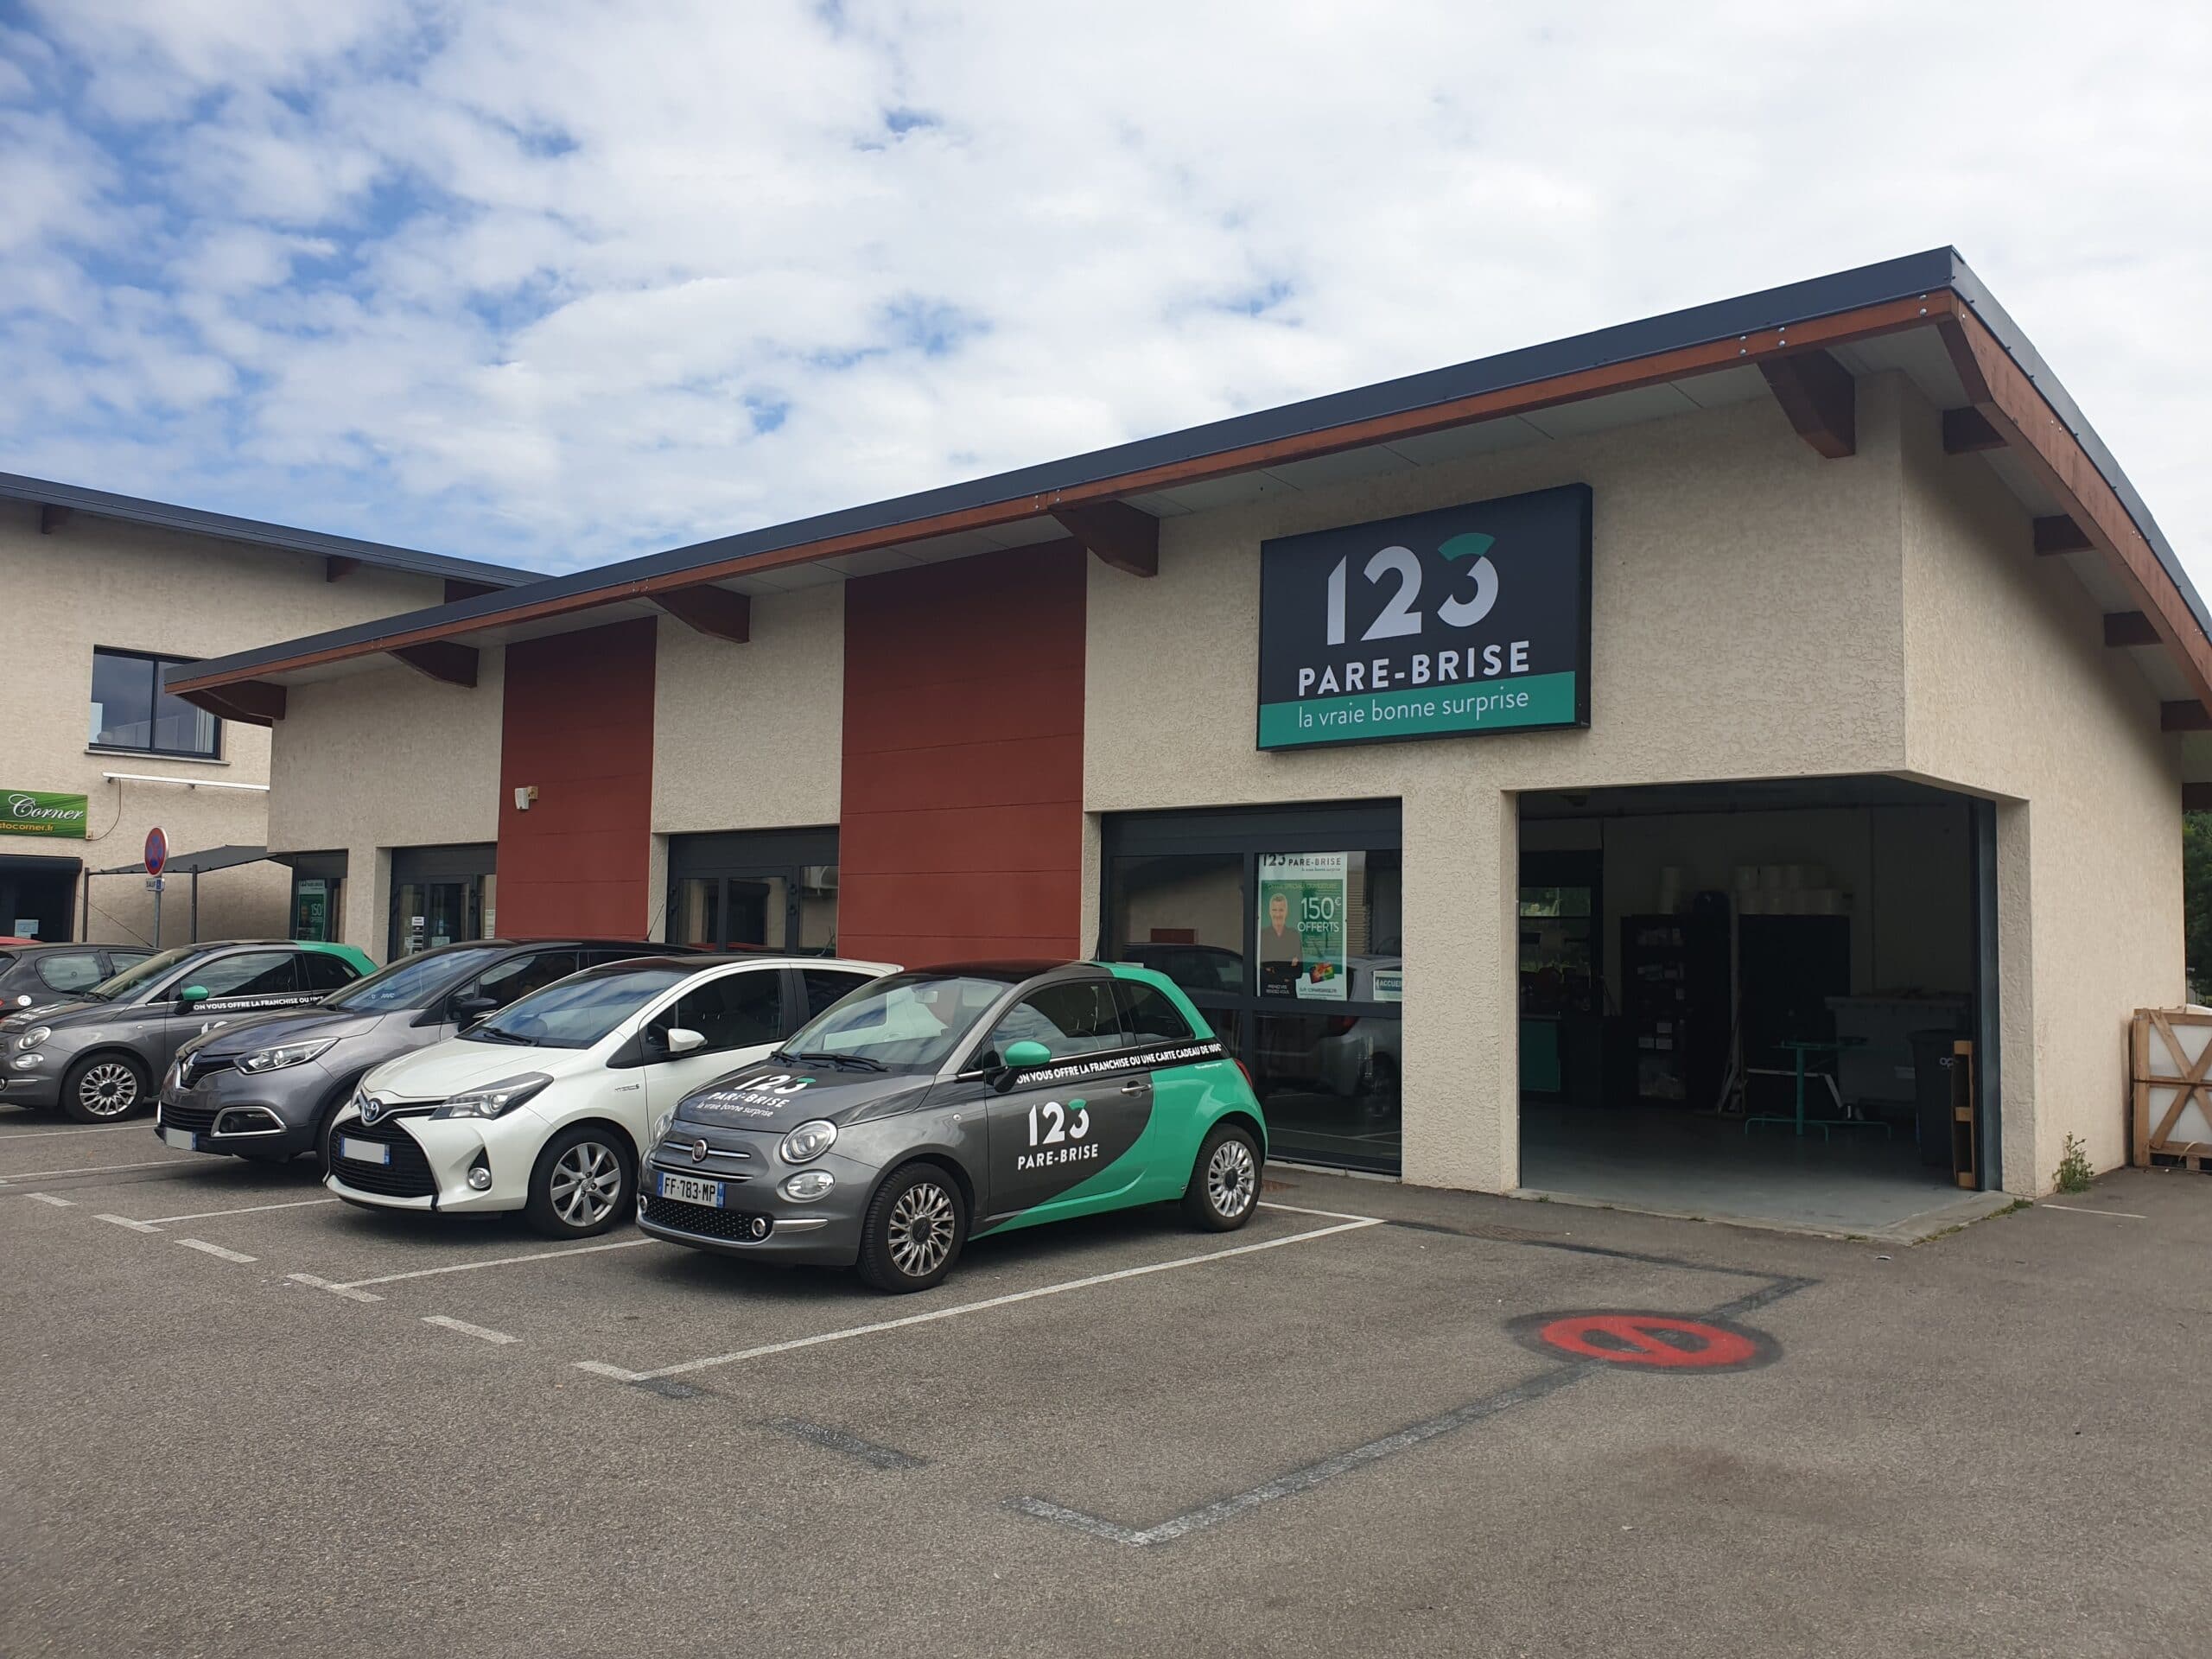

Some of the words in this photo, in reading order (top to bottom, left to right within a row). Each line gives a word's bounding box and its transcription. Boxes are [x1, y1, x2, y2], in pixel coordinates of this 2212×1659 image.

[1326, 532, 1499, 646] 123
[1298, 640, 1529, 696] PARE-BRISE
[1299, 707, 1313, 728] la
[1319, 702, 1364, 726] vraie
[1371, 699, 1435, 721] bonne
[1442, 686, 1529, 721] surprise
[8, 793, 84, 820] Corner
[1288, 857, 1341, 867] PARE-BRISE
[1297, 921, 1339, 932] OFFERTS
[1379, 979, 1402, 988] ACCUEI
[261, 997, 298, 1007] FRANCHISE
[1017, 1072, 1031, 1084] ON
[1031, 1070, 1053, 1082] VOUS
[1054, 1065, 1079, 1078] OFFRE
[1078, 1064, 1090, 1075] LA
[1089, 1057, 1130, 1073] FRANCHISE
[1129, 1056, 1141, 1065] OU
[1141, 1052, 1156, 1064] UNE
[1155, 1050, 1177, 1061] CARTE
[1176, 1046, 1201, 1058] CADEAU
[1200, 1045, 1210, 1055] DE
[734, 1074, 817, 1095] 123
[707, 1091, 791, 1109] PARE-BRISE
[720, 1103, 744, 1112] bonne
[743, 1107, 774, 1118] surprise
[1028, 1098, 1090, 1147] 123
[1017, 1143, 1098, 1171] PARE-BRISE
[664, 1177, 716, 1202] FF-783-MP
